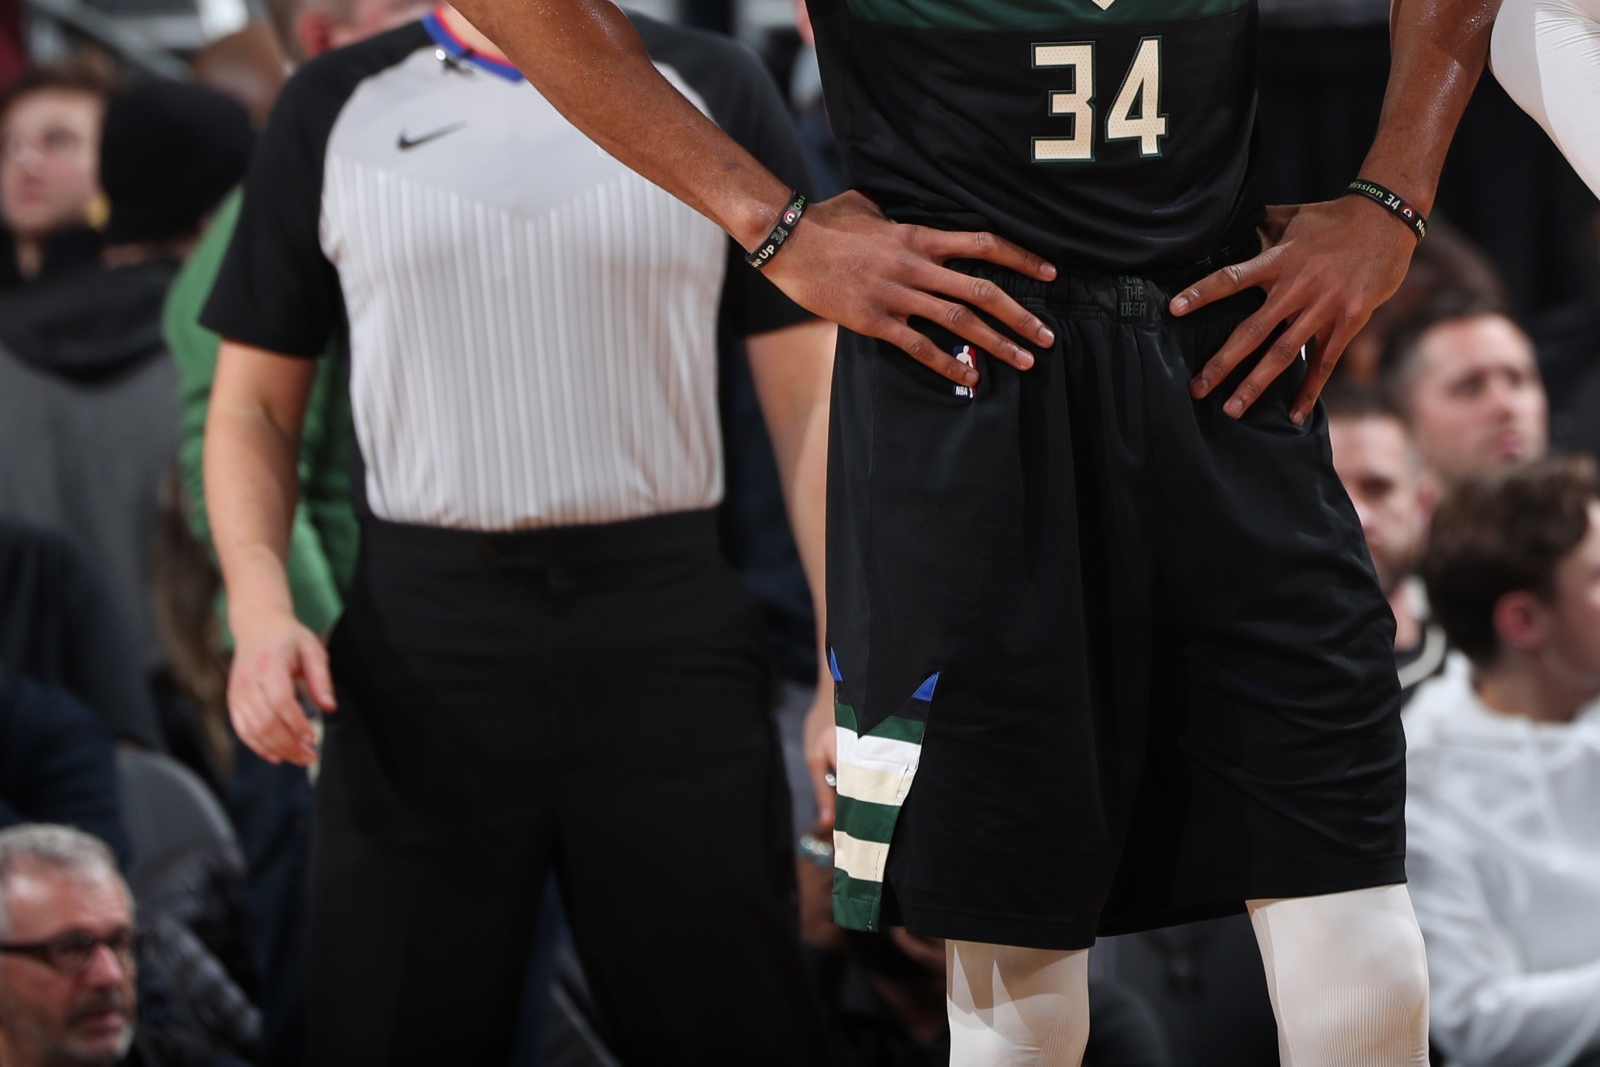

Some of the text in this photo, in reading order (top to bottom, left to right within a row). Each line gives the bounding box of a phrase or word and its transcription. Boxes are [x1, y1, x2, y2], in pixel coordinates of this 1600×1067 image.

[1031, 35, 1169, 163] 34
[1384, 194, 1401, 210] 34
[758, 244, 775, 260] Up
[1124, 286, 1144, 301] THE
[1121, 302, 1147, 317] DEER
